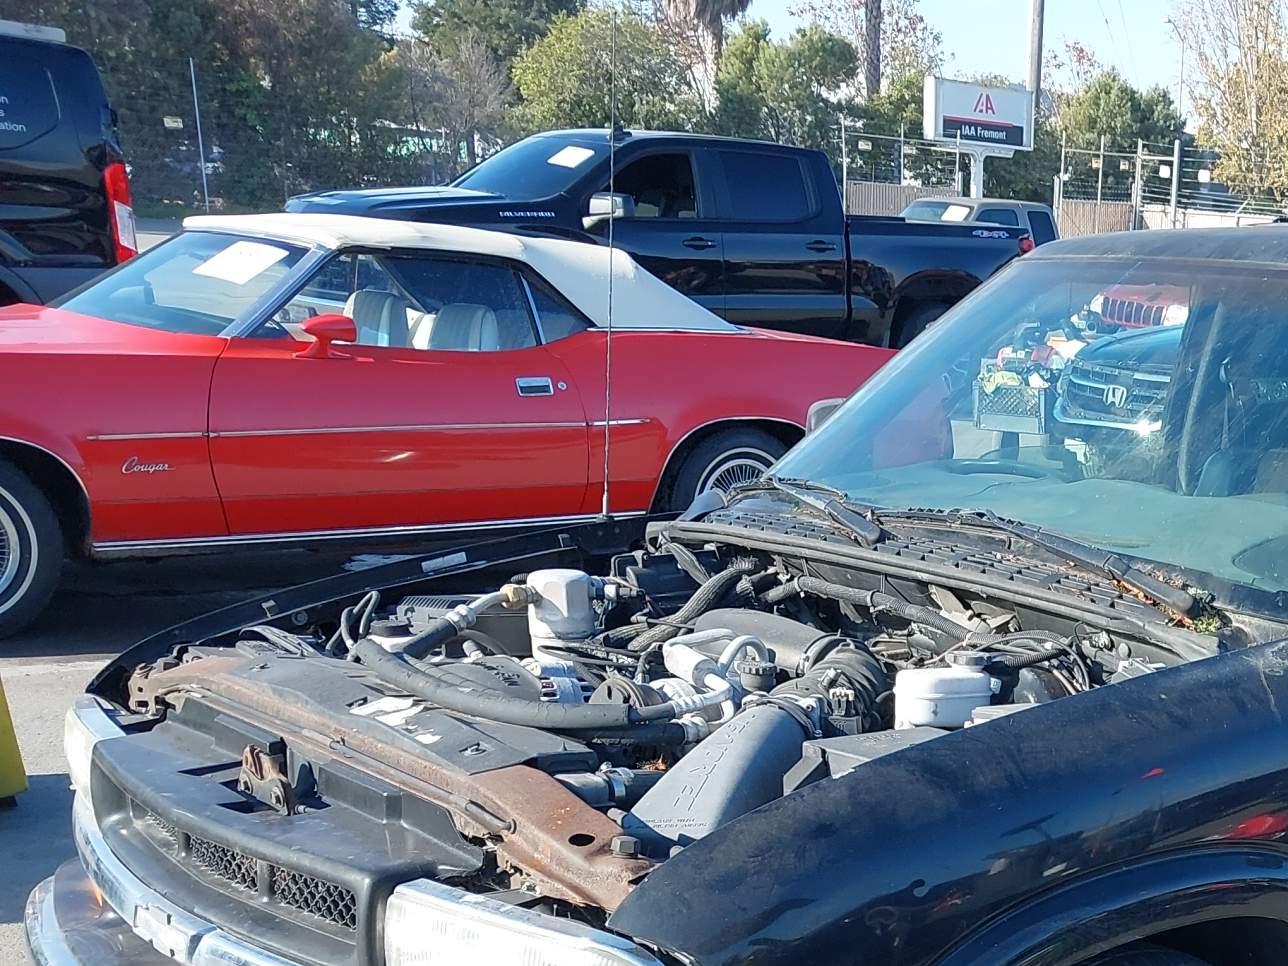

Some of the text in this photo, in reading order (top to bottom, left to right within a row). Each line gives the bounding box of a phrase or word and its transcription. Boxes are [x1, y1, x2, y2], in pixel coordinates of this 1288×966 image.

[961, 124, 1006, 140] IAA Fremont
[121, 455, 177, 474] Cougar
